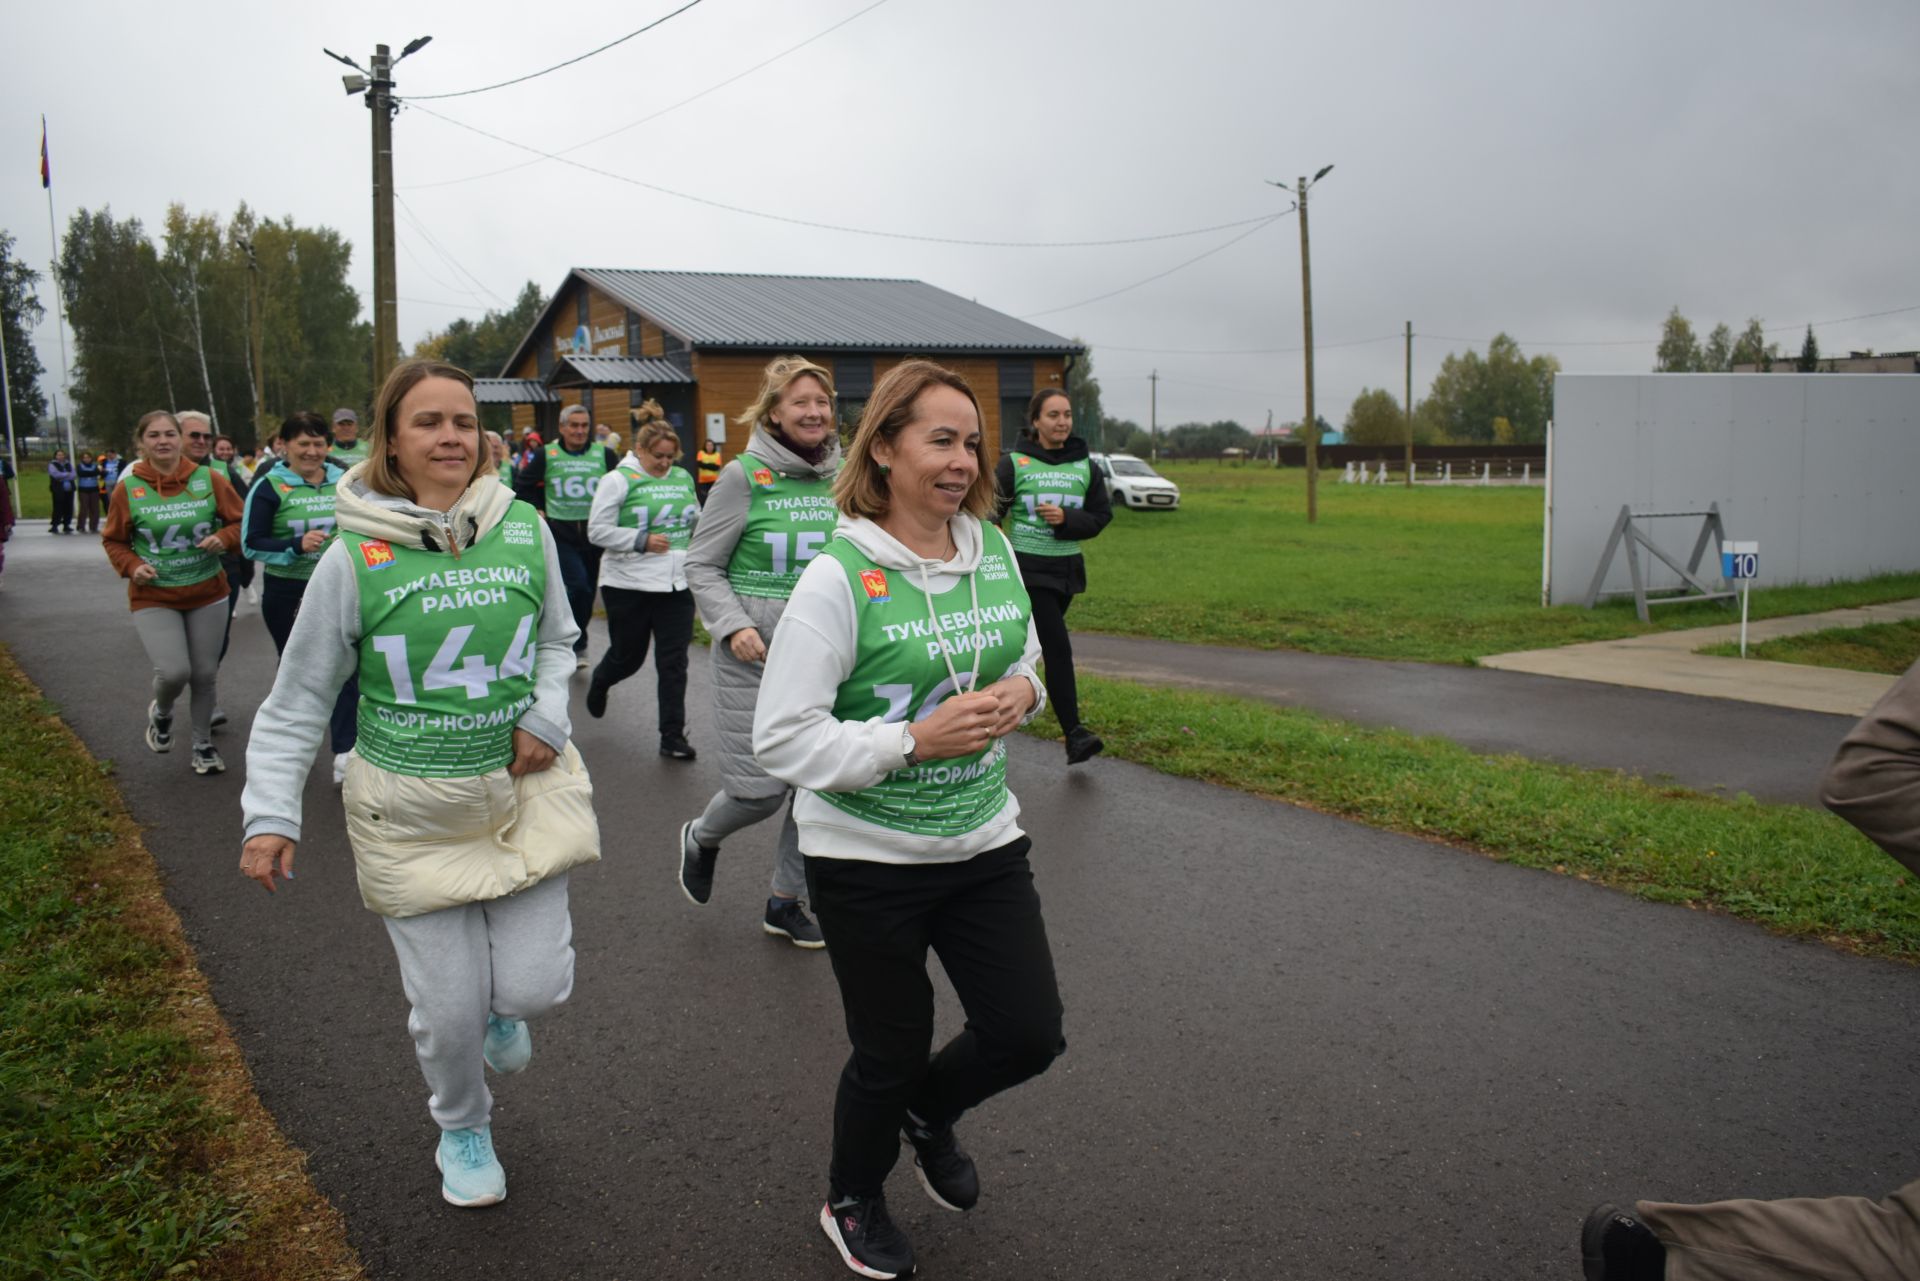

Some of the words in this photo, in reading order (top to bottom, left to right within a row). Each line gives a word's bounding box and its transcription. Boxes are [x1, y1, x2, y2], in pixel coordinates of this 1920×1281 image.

[1038, 479, 1072, 489] РАЙОН
[139, 499, 208, 514] ТУКАЕВСКИЙ
[306, 503, 337, 512] РАЙО
[765, 496, 836, 511] ТУКАЕВСК
[157, 509, 196, 521] РАЙОН
[790, 508, 834, 522] РАЙОН
[503, 529, 533, 538] НОРМА
[504, 537, 534, 546] ЖИЗНИ
[763, 531, 826, 576] 15
[979, 562, 1007, 573] НОРМА
[1735, 554, 1757, 577] 10
[384, 565, 531, 604] ТУКАЕВСКИЙ
[422, 587, 508, 614] РАЙОН
[882, 600, 1023, 642] ТУКАЕВСКИЙ
[926, 629, 1004, 660] РАЙОН
[372, 613, 537, 704] 144
[376, 706, 428, 730] СПОРТ
[443, 702, 514, 732] НОРМА
